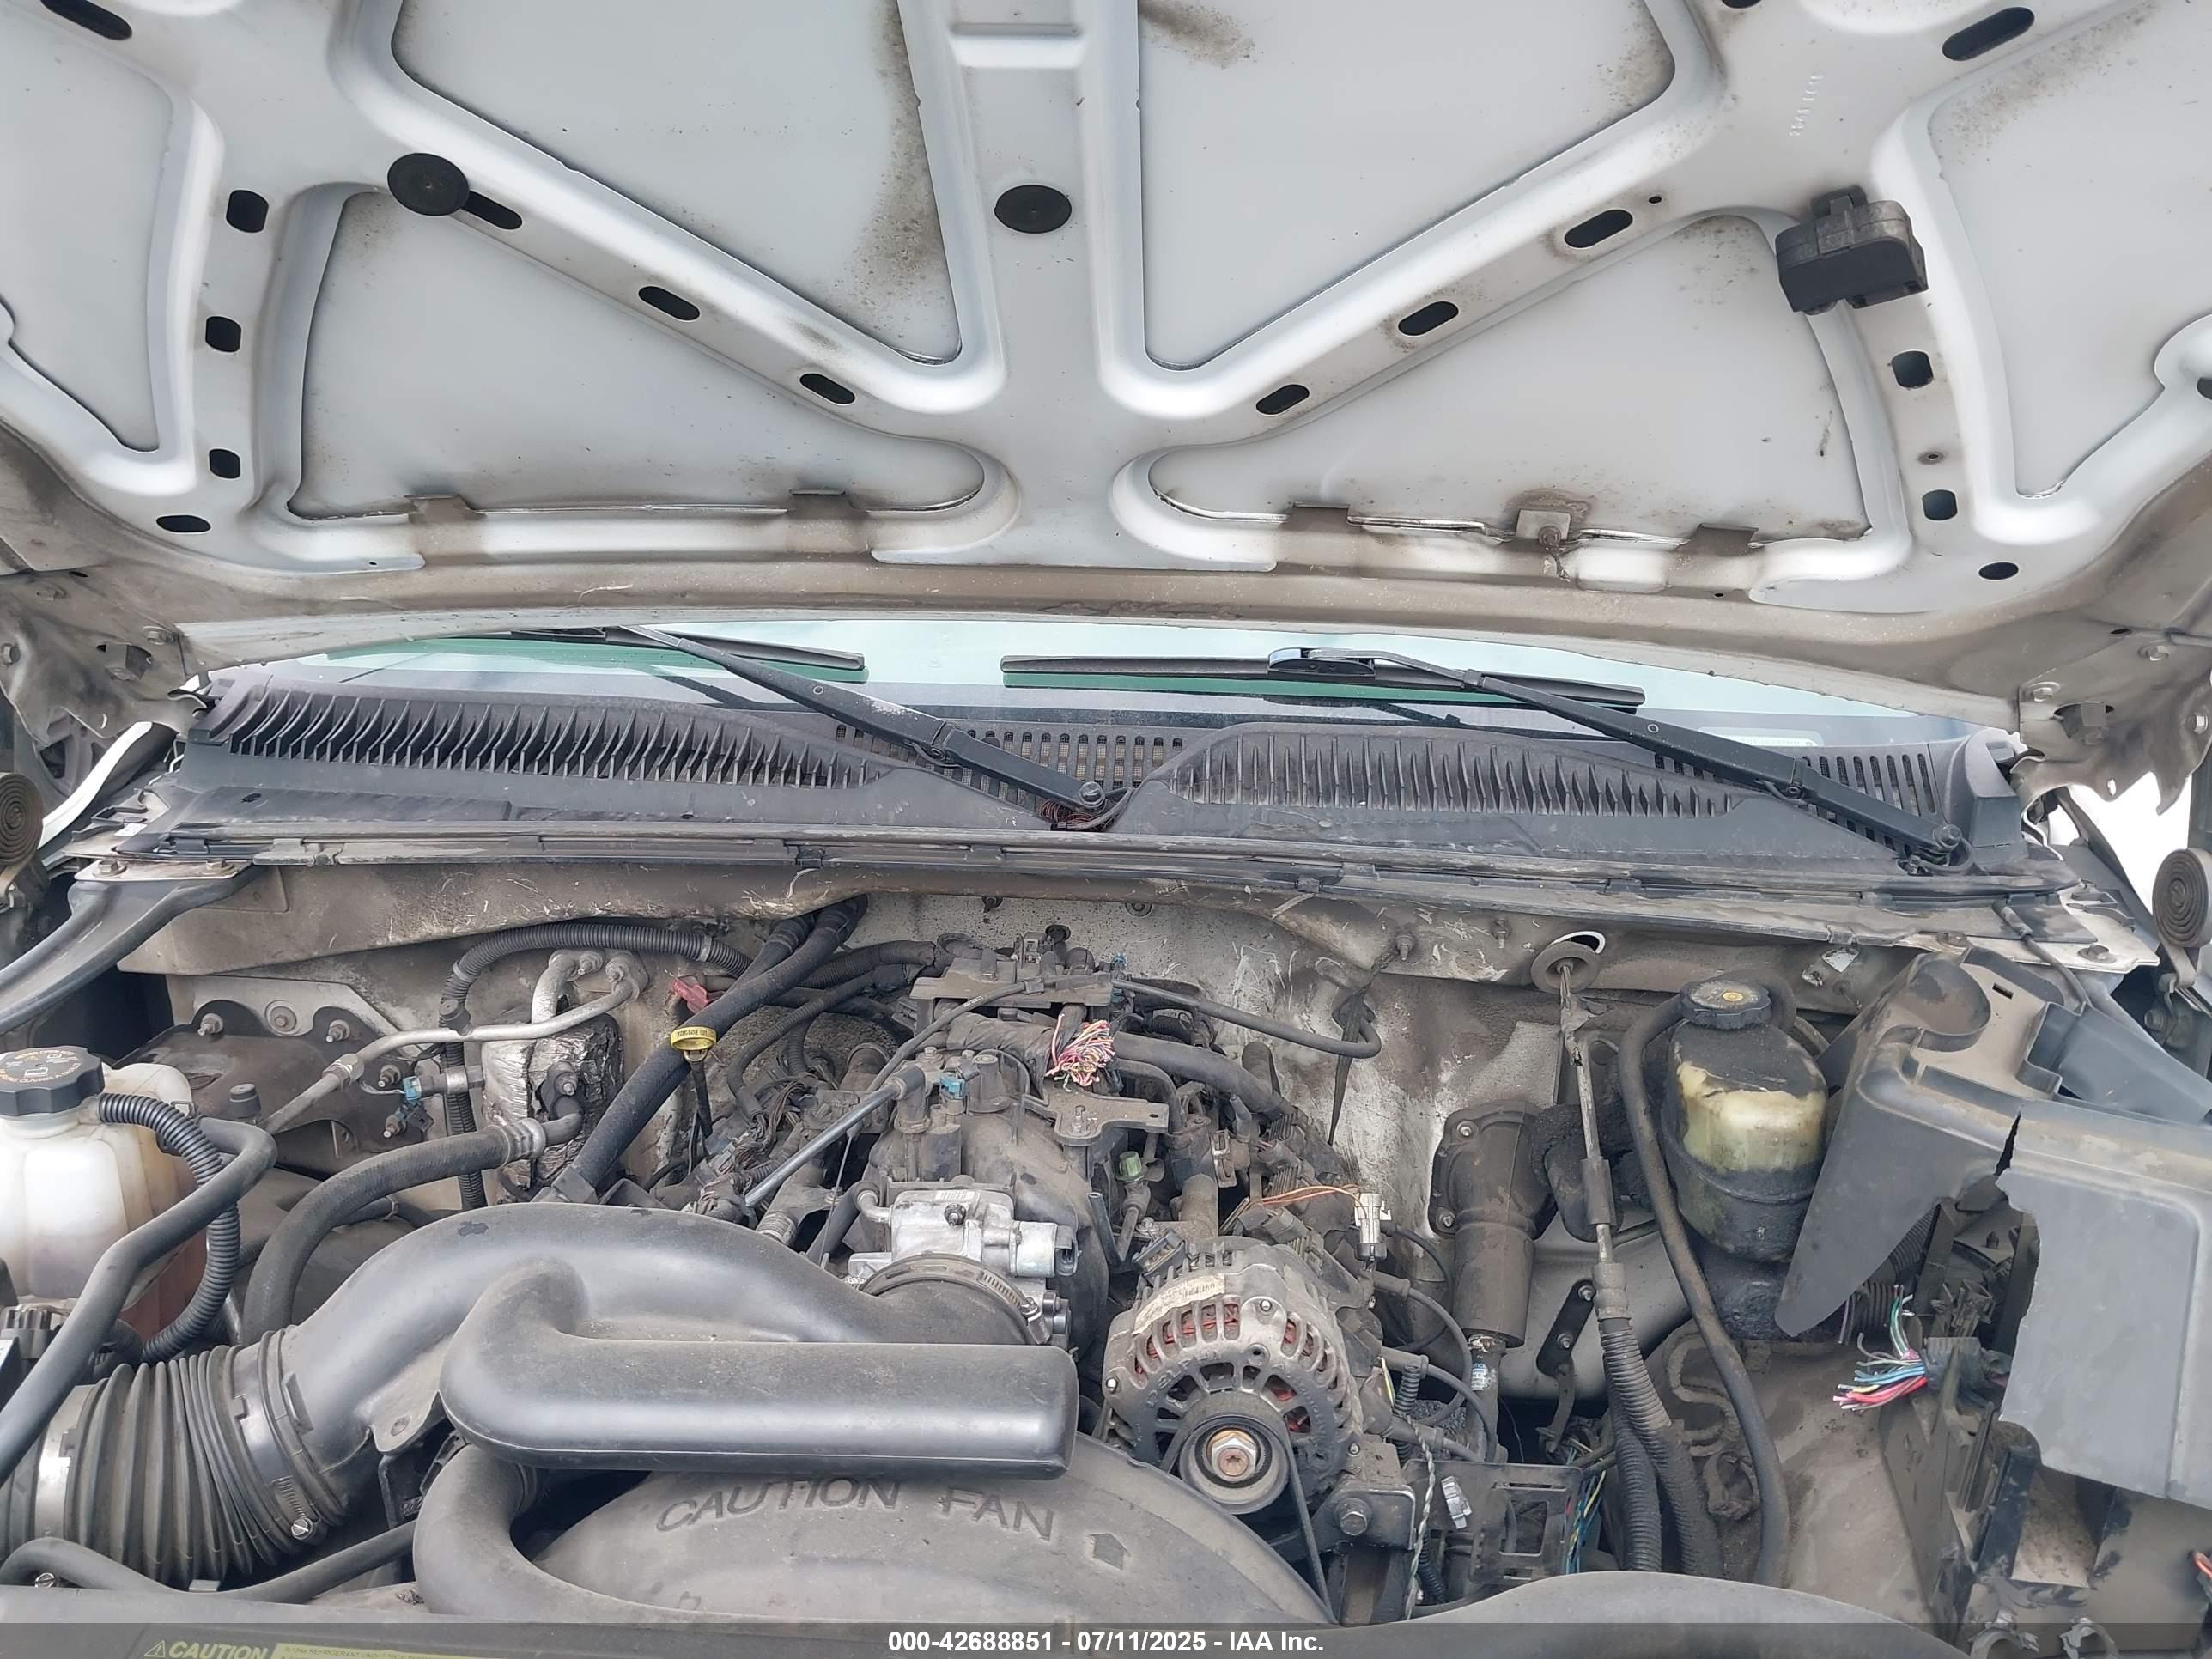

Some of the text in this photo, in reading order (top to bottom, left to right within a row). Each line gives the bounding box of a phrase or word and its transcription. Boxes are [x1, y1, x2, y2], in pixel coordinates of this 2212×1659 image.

[655, 1476, 1054, 1541] CAUTION FAN
[168, 1641, 269, 1659] CAUTION
